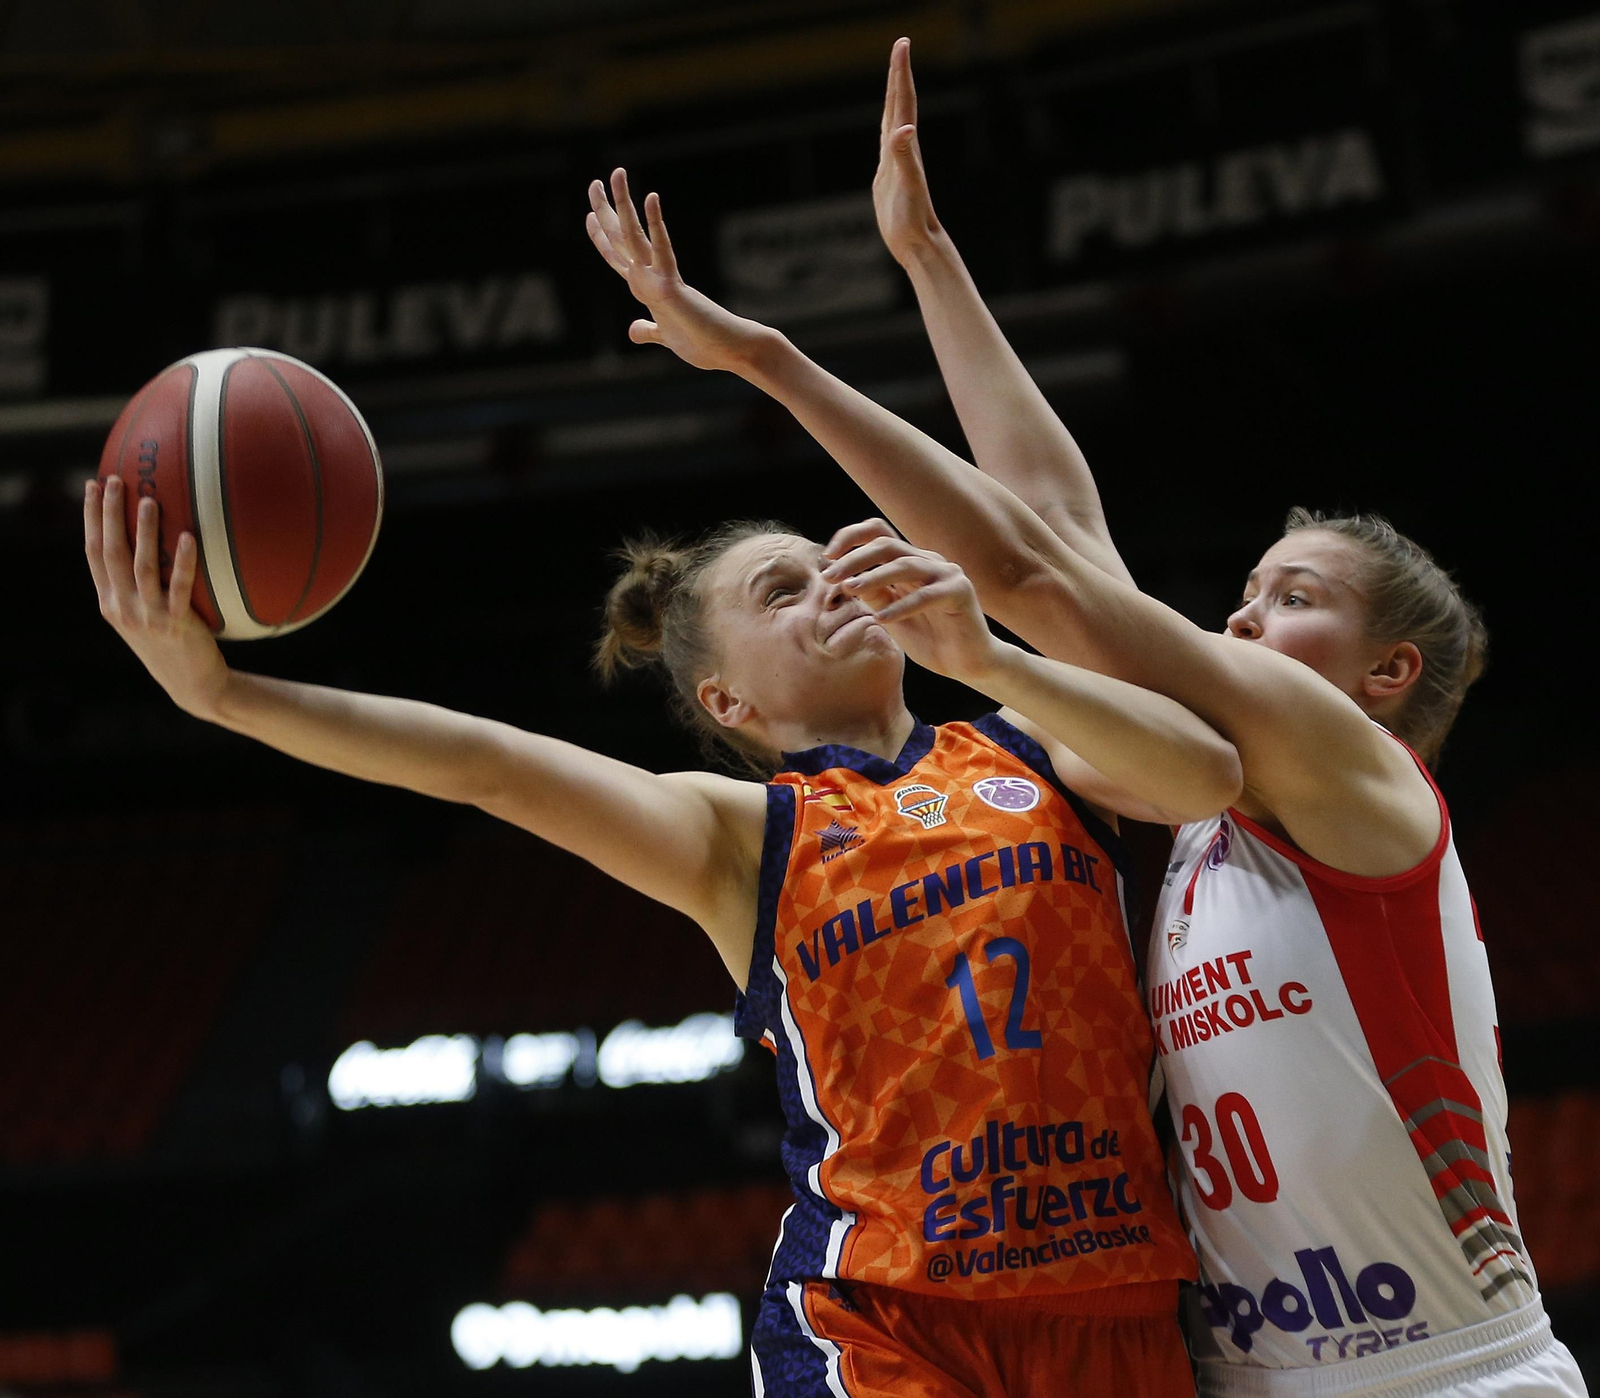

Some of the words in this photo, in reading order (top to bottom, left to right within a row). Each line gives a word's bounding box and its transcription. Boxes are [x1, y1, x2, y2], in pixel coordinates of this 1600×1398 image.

[1045, 128, 1386, 262] PULEVA
[213, 273, 565, 367] PULEVA
[796, 841, 1054, 983] VALENCIA
[944, 936, 1043, 1061] 12
[1169, 981, 1313, 1051] MISKOLC
[920, 1120, 1086, 1196] Cultura
[1181, 1091, 1280, 1212] 30
[927, 1223, 1157, 1283] @ValenciaBaske
